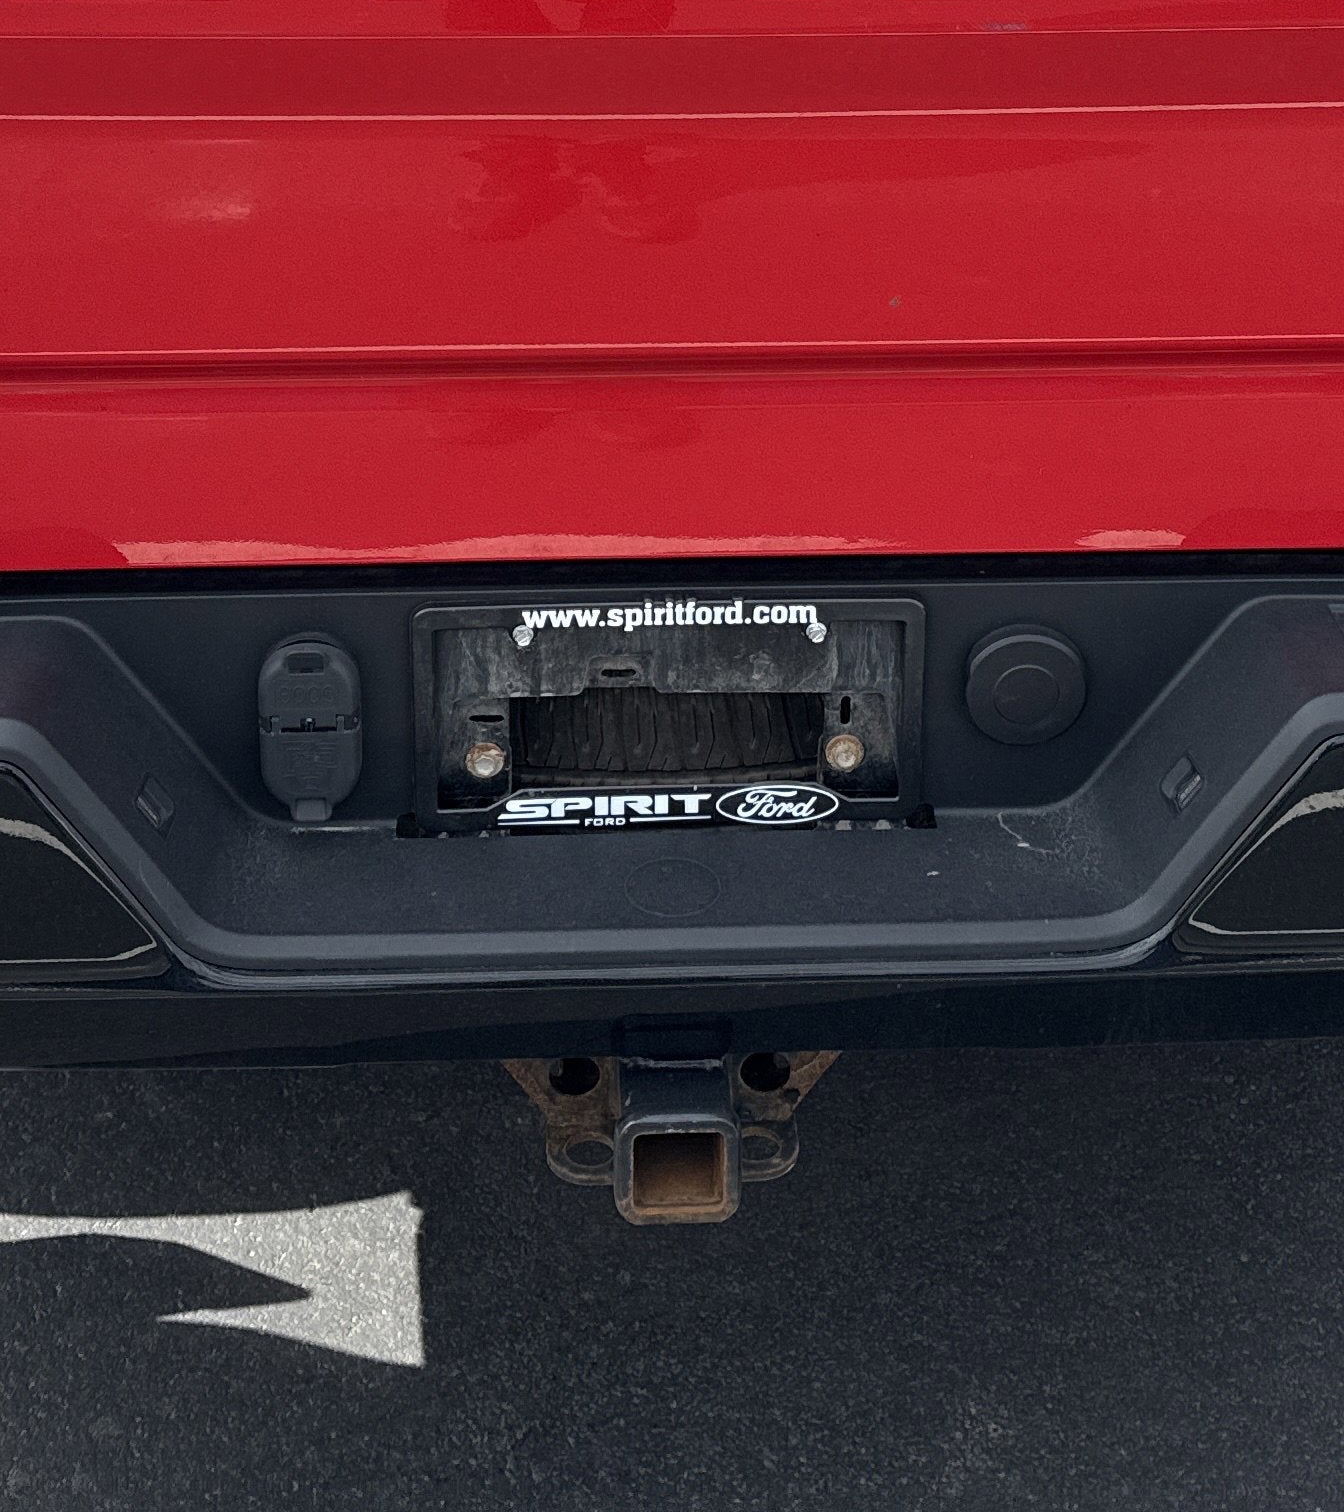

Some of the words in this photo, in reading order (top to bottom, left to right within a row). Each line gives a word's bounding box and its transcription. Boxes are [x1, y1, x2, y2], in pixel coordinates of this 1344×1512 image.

[521, 600, 819, 632] www.spiritford.com
[497, 793, 712, 820] SPIRIT
[736, 790, 819, 819] Ford
[584, 817, 626, 827] FORD
